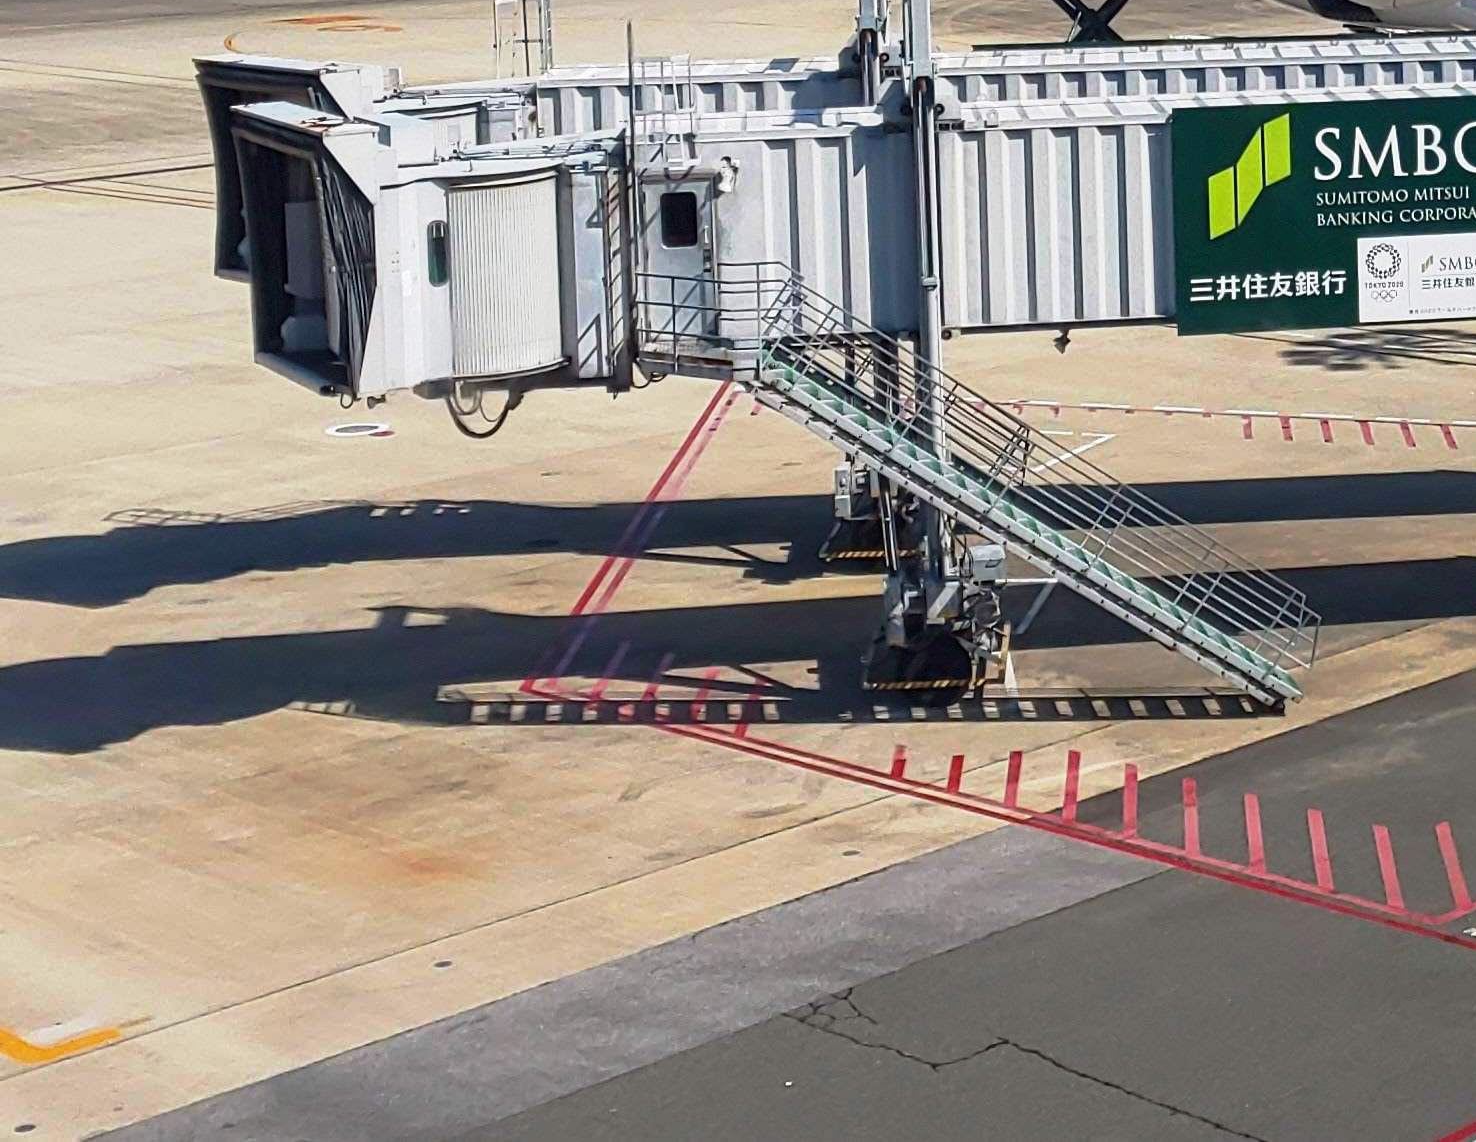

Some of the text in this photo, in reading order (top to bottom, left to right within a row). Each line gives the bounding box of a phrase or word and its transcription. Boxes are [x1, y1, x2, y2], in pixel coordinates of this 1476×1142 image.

[1316, 185, 1470, 207] SUMITOMO MITSUI
[1316, 210, 1394, 227] BANKING
[1189, 269, 1347, 303] 三井住友銀行
[1365, 282, 1387, 290] TOKYO
